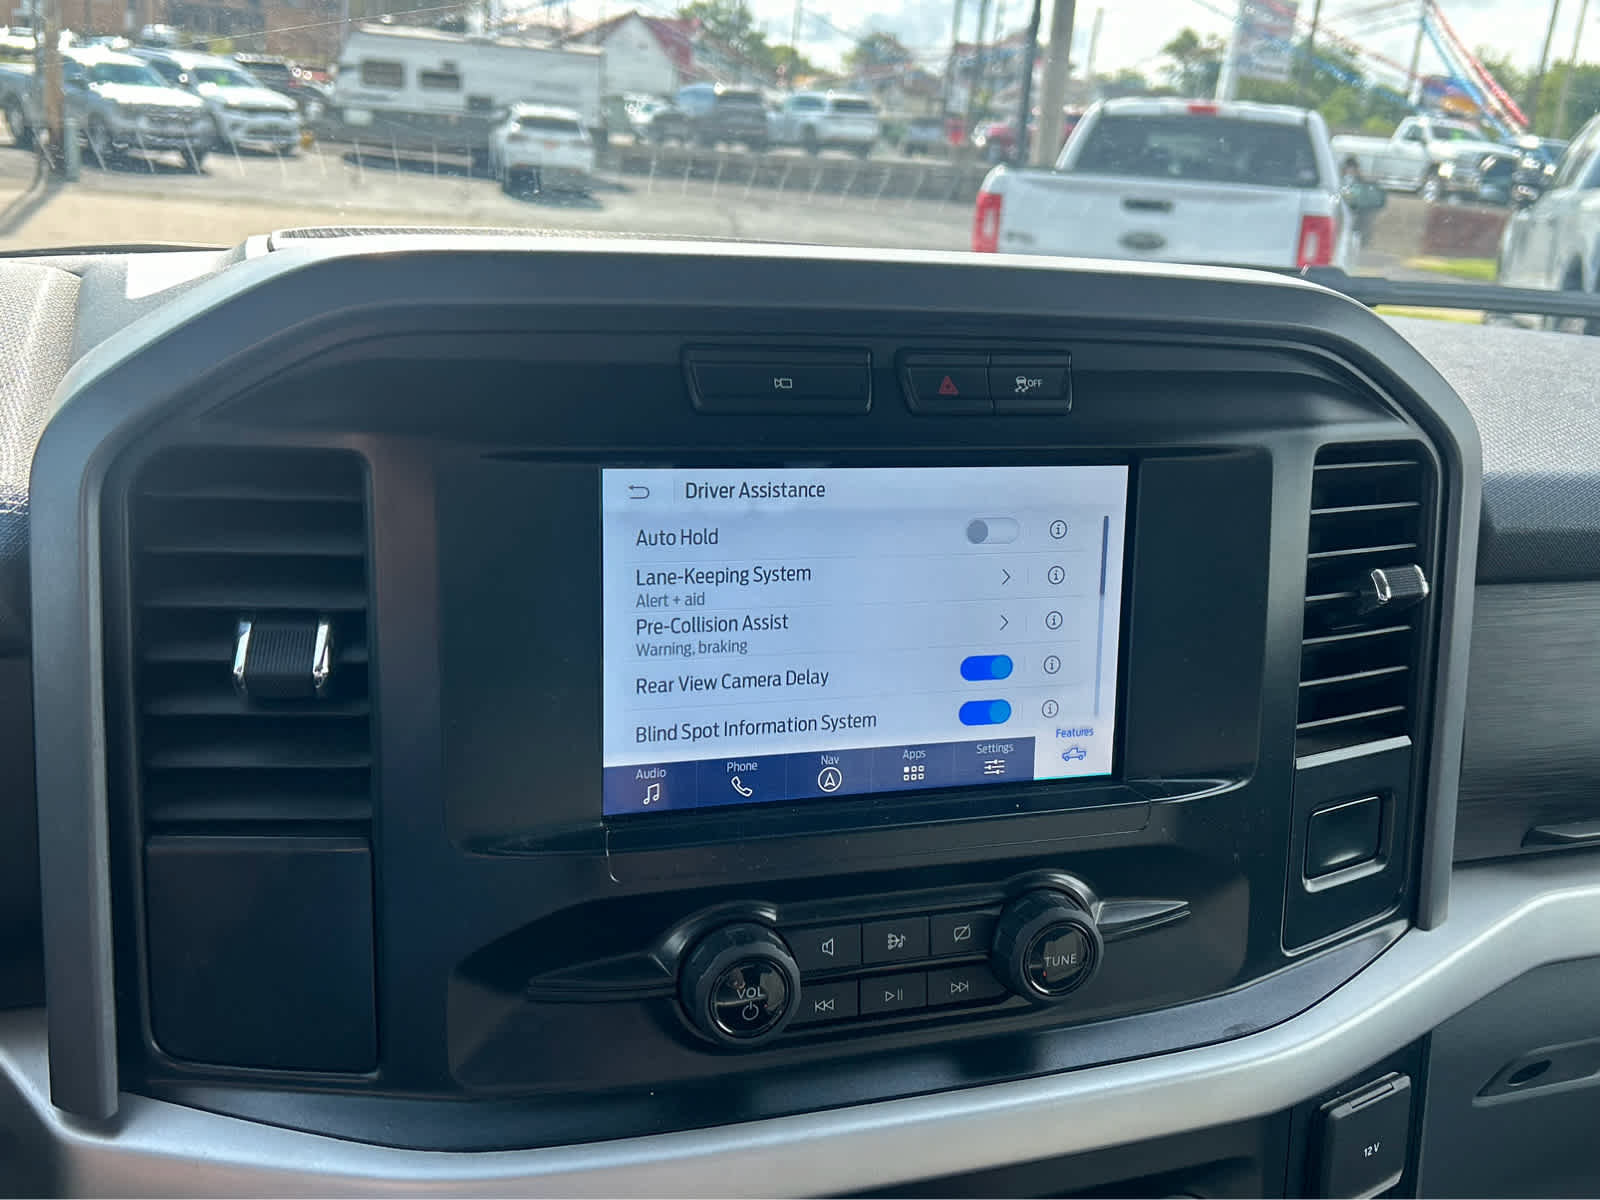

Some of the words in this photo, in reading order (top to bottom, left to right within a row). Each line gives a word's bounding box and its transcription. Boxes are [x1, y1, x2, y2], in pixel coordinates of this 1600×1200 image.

[1028, 378, 1043, 388] OFF
[685, 482, 735, 499] Driver
[738, 481, 826, 498] Assistance
[636, 529, 676, 546] Auto
[681, 527, 719, 545] Hold
[635, 567, 750, 587] Lane-Keeping
[753, 565, 812, 584] System
[635, 593, 669, 608] Alert
[684, 592, 705, 606] aid
[636, 616, 739, 635] Pre-Collision
[742, 614, 789, 631] Assist
[635, 641, 696, 657] Warning,
[698, 640, 748, 655] braking
[636, 677, 674, 695] Rear
[678, 675, 718, 691] View
[721, 672, 782, 689] Camera
[785, 669, 829, 688] Delay
[636, 724, 678, 743] Blind
[681, 722, 720, 742] Spot
[724, 716, 817, 737] Information
[821, 713, 877, 732] System
[1055, 727, 1094, 739] Features
[902, 750, 926, 760] Apps
[976, 743, 1014, 755] Settings
[726, 761, 758, 773] Phone
[821, 755, 840, 765] Nav
[636, 768, 666, 780] Audio
[1044, 953, 1077, 967] TUNE
[736, 986, 766, 1000] VOL
